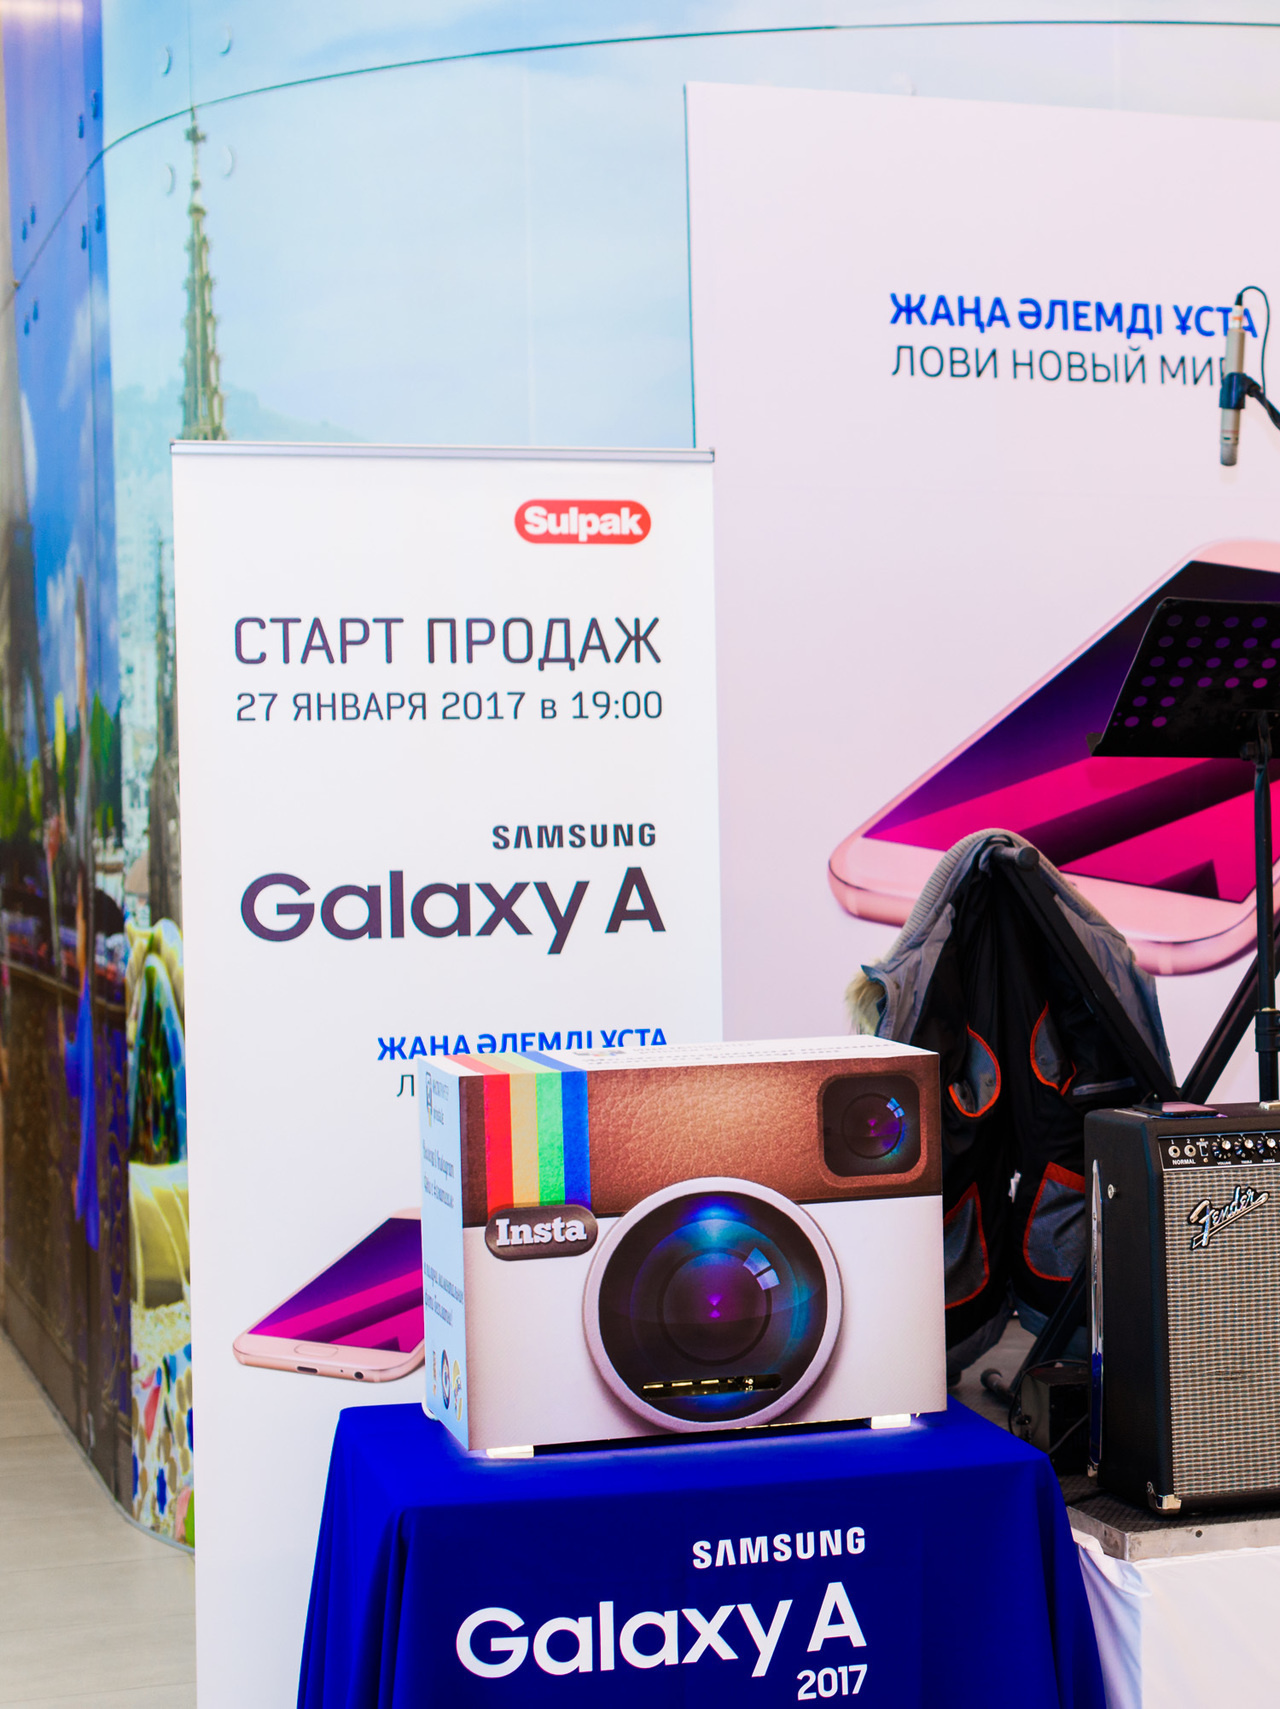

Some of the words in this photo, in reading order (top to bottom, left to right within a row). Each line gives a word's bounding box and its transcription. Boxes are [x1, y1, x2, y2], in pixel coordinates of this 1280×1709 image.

[890, 292, 1011, 333] ЖАҢА
[1017, 297, 1163, 340] ӘЛЕМДІ
[891, 345, 998, 378] ЛОВИ
[1012, 345, 1146, 384] НОВЫЙ
[524, 506, 643, 541] Sulpak
[234, 617, 404, 665] СТАРТ
[427, 617, 661, 671] ПРОДАЖ
[236, 693, 278, 722] 27
[292, 692, 428, 721] ЯНВАРЯ
[441, 691, 527, 720] 2017
[540, 698, 557, 719] в
[571, 691, 663, 720] 19:00
[491, 823, 657, 850] SAMSUNG
[240, 870, 590, 955] Galaxy
[604, 866, 667, 934] A
[1172, 1158, 1196, 1166] NORMAL
[496, 1216, 588, 1246] Insta
[1188, 1185, 1269, 1249] Fender
[692, 1526, 866, 1569] SAMSUNG
[455, 1599, 794, 1679] Galaxy
[806, 1581, 867, 1652] A
[797, 1663, 868, 1700] 2017
